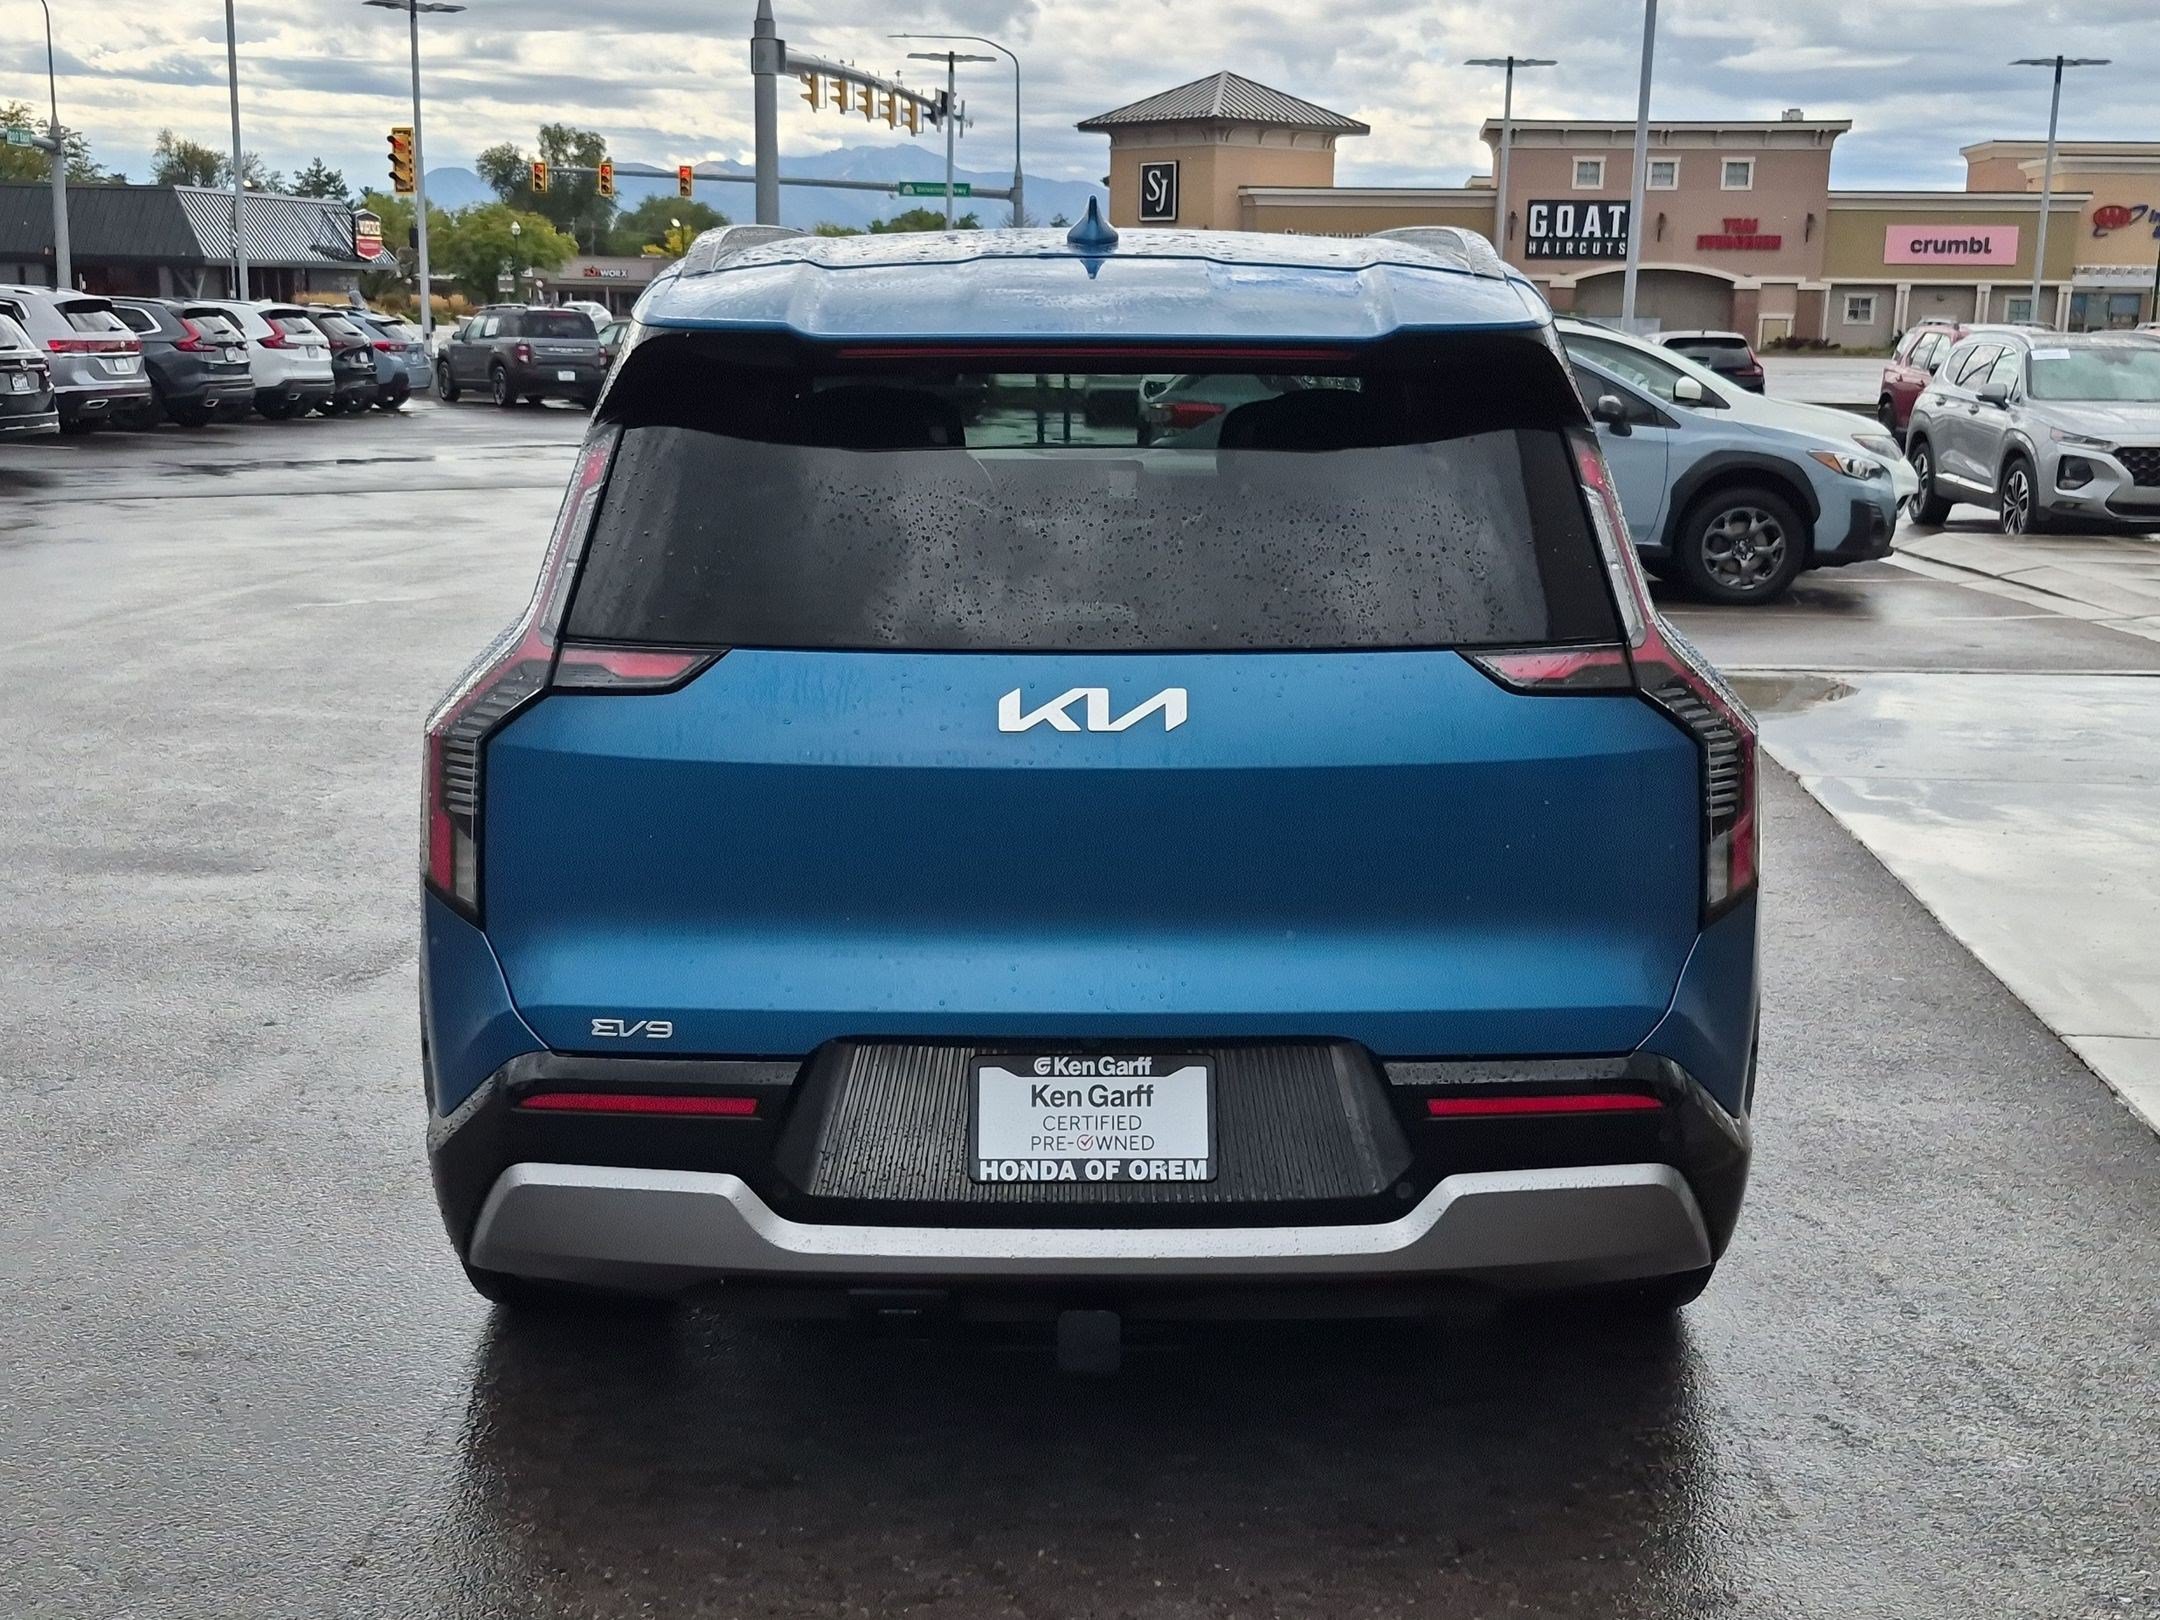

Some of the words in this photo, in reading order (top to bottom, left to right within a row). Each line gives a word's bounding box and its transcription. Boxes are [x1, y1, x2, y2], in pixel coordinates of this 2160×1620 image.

[1529, 204, 1627, 238] G.O.A.T.
[1528, 241, 1626, 255] HAIRCUTS
[1909, 236, 1993, 255] crumbl
[591, 1018, 673, 1039] EV9
[1054, 1056, 1095, 1076] Ken
[1098, 1056, 1152, 1076] Garff
[1031, 1084, 1083, 1108] Ken
[1088, 1084, 1154, 1108] Garff
[1042, 1115, 1142, 1131] CERTIFIED
[979, 1160, 1077, 1181] HONDA
[1085, 1160, 1121, 1181] OF
[1128, 1160, 1208, 1181] OREM
